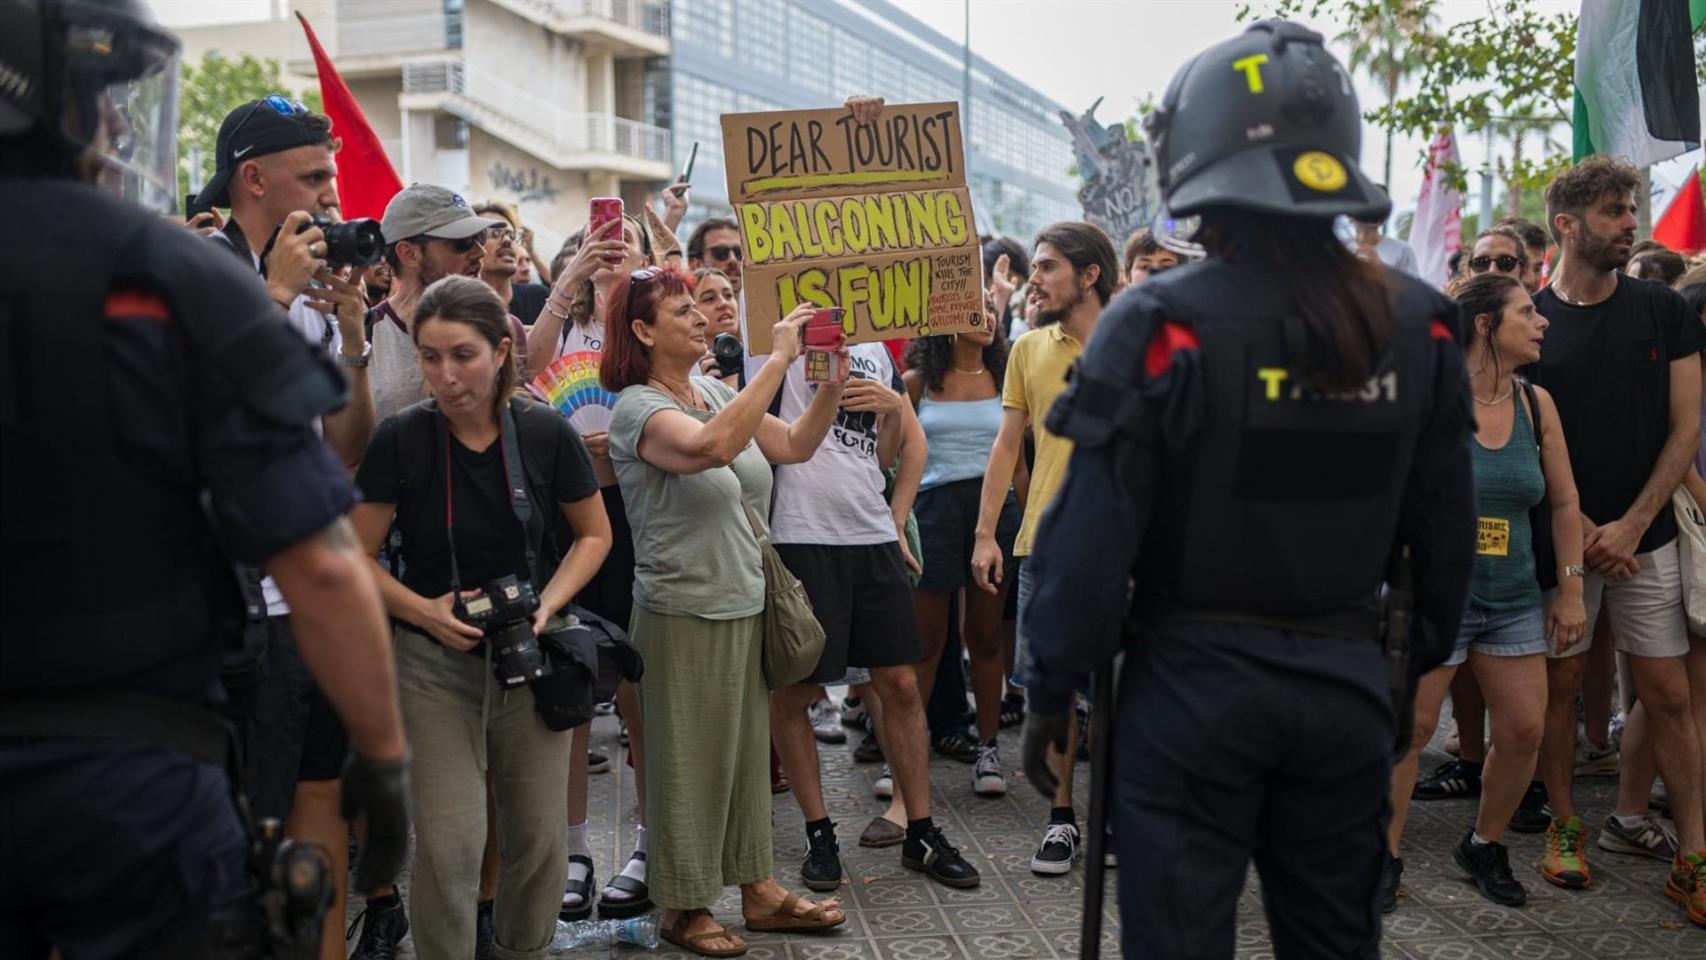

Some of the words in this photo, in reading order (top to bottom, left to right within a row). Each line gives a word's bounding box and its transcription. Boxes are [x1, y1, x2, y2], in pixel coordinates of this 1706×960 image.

[1233, 54, 1269, 93] T
[746, 120, 832, 175] DEAR
[836, 111, 953, 174] TOURIST
[741, 190, 970, 263] BALCONING
[936, 254, 971, 268] TOURISM
[776, 266, 839, 322] IS
[837, 255, 933, 336] FUN!
[851, 355, 877, 376] MO
[1477, 520, 1507, 532] RISME
